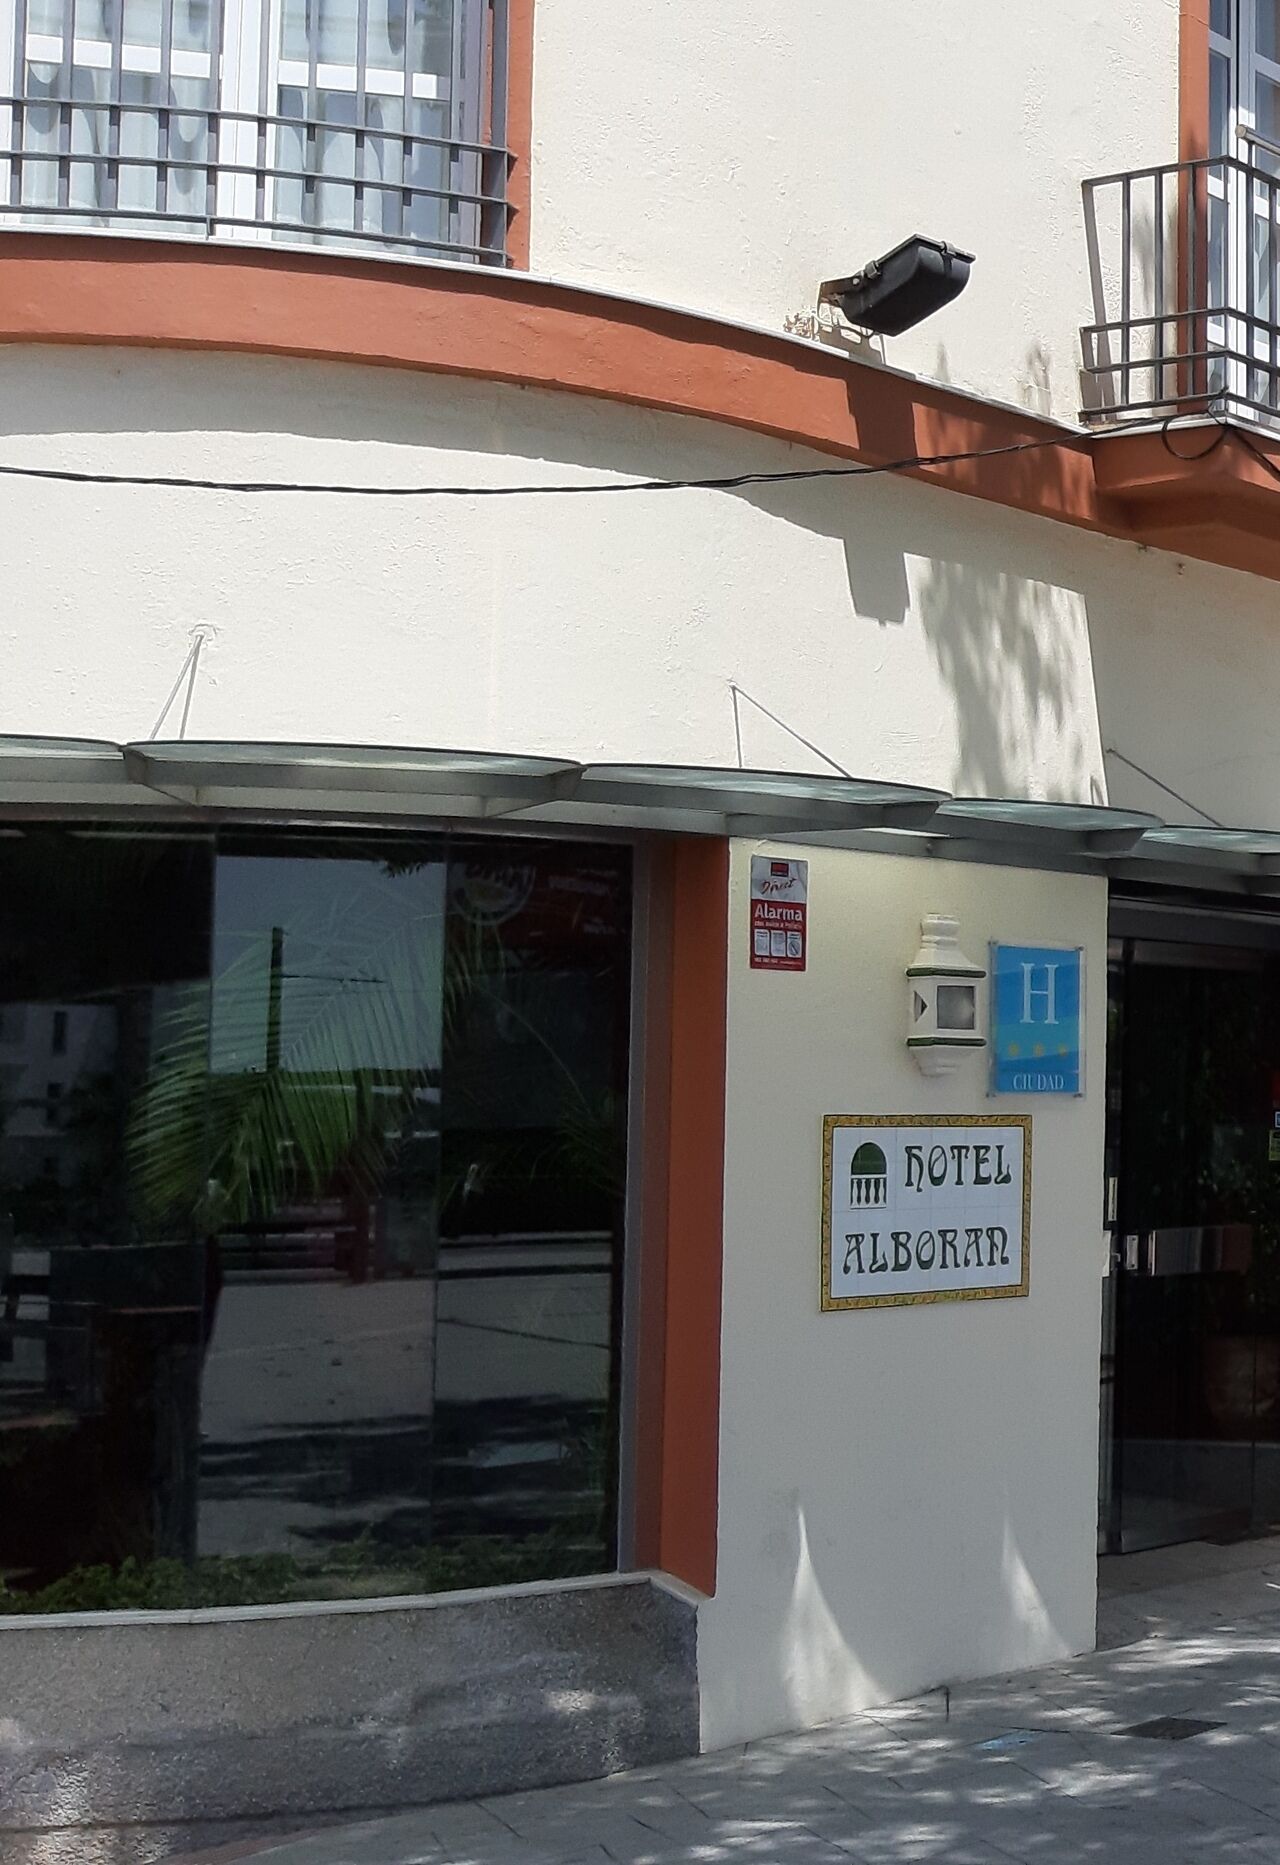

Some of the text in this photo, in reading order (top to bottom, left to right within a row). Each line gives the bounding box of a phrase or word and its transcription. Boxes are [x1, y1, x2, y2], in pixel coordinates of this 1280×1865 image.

[754, 902, 803, 922] Alarma
[1020, 962, 1060, 1025] H
[1012, 1073, 1065, 1091] CIUDAD
[904, 1143, 1012, 1193] HOTEL
[842, 1225, 1010, 1275] ALBORAN
